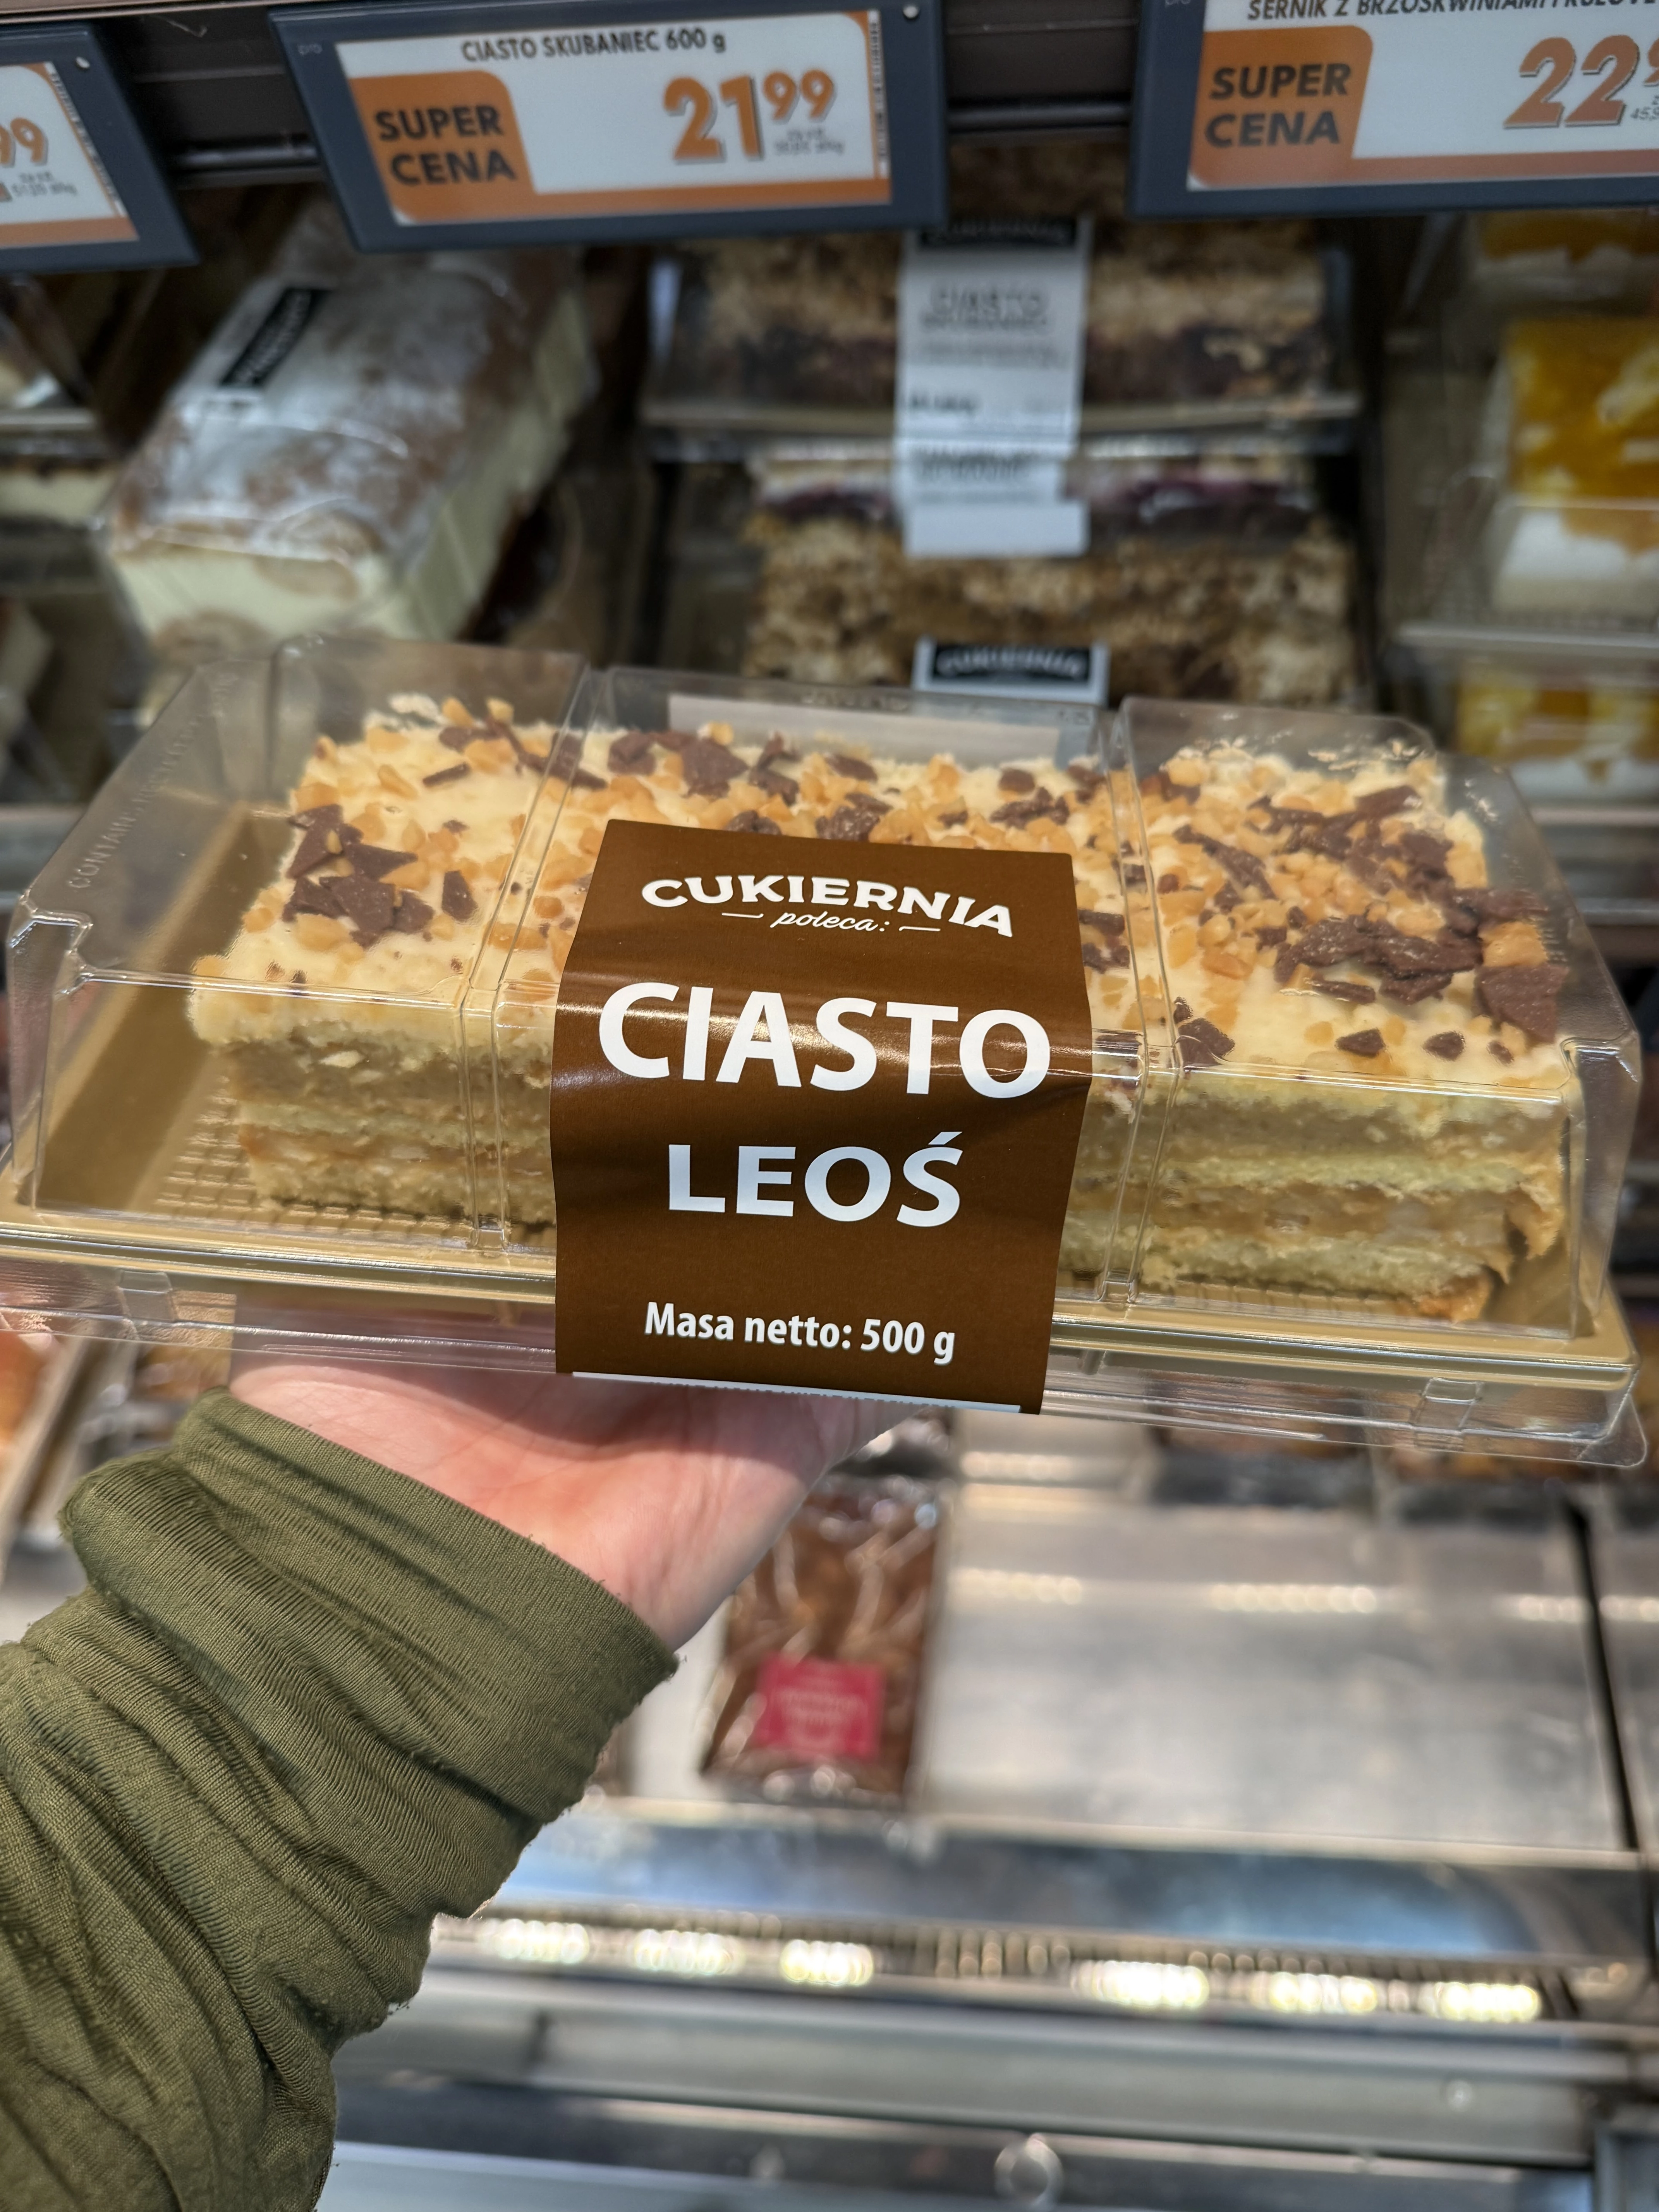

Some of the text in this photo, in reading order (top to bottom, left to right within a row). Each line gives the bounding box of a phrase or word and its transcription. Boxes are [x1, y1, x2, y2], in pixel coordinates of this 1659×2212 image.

[1248, 0, 1327, 20] SERNIK
[1334, 0, 1349, 16] Z
[461, 28, 726, 62] CIASTO SKUBANIEC 600 g
[1209, 62, 1352, 100] SUPER
[375, 104, 504, 142] SUPER
[1204, 110, 1340, 148] CENA
[390, 149, 516, 186] CENA
[641, 874, 1013, 938] CUKIERNIA
[769, 911, 890, 932] poleca:
[599, 982, 1051, 1099] CIASTO
[669, 1131, 963, 1227] LEOŚ
[644, 1301, 956, 1365] Masa netto: 500 g
